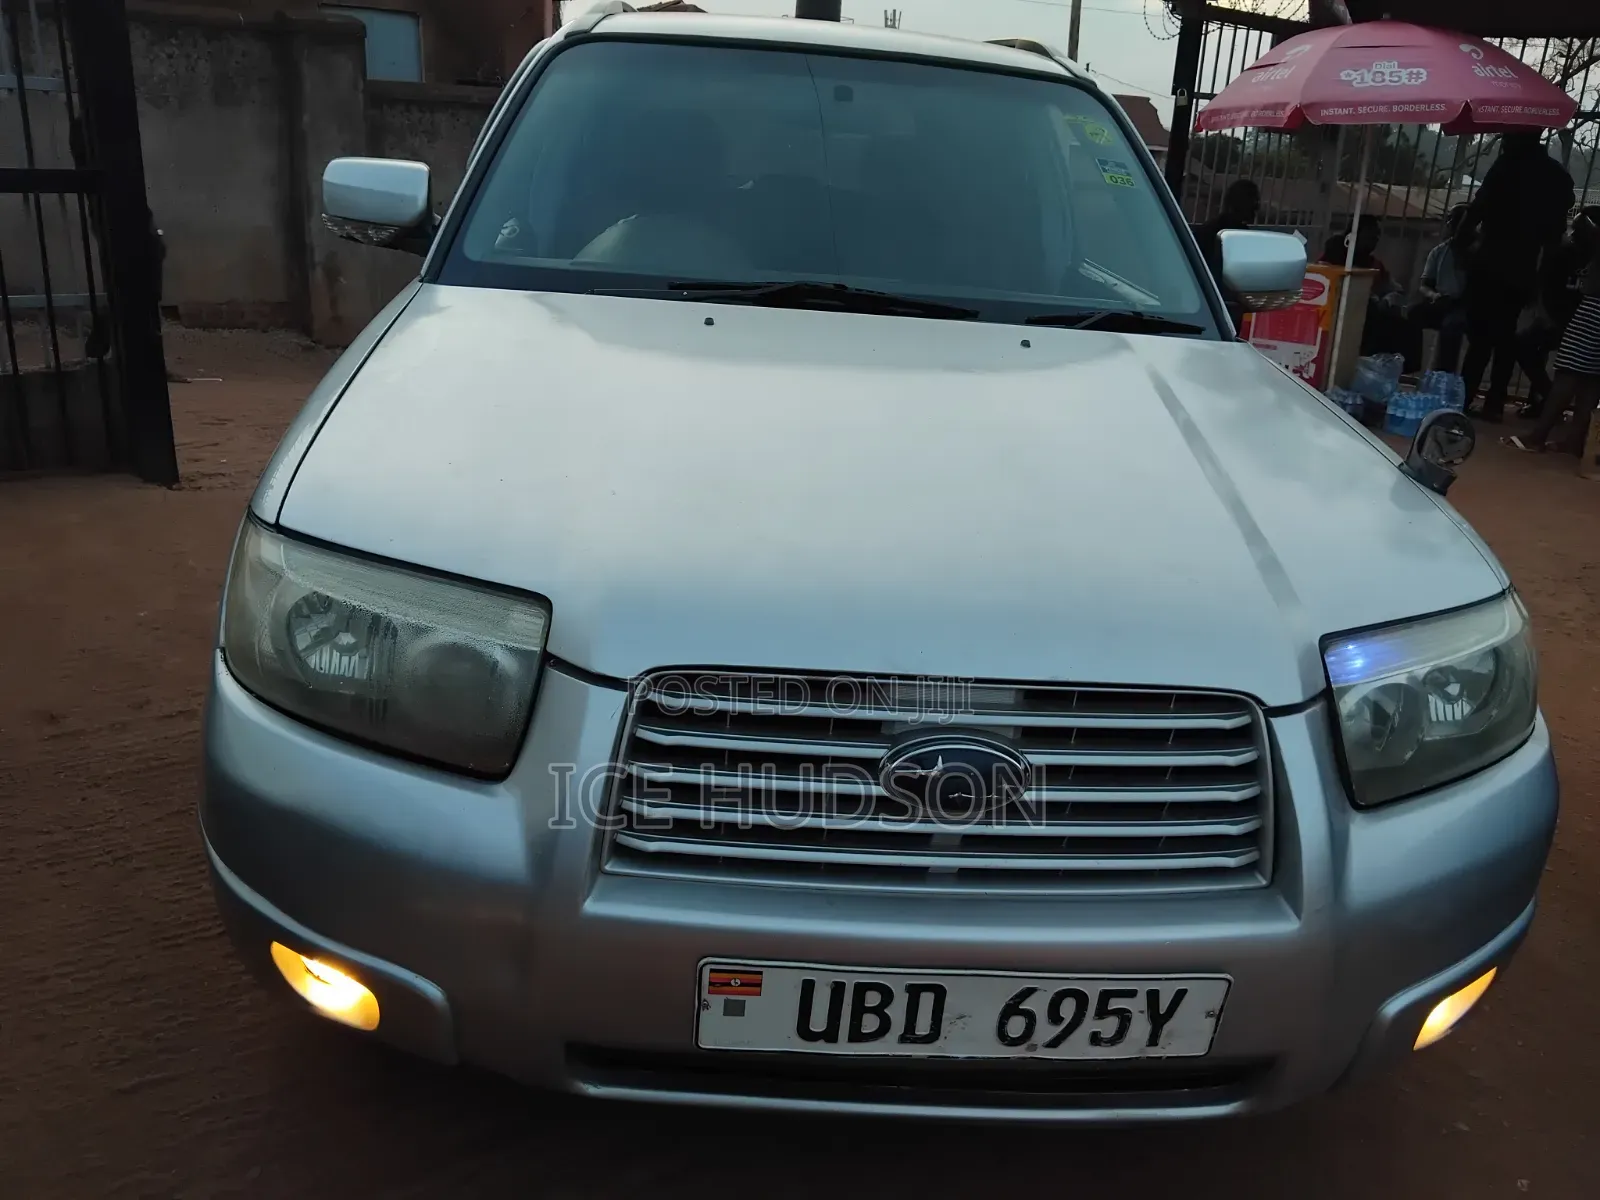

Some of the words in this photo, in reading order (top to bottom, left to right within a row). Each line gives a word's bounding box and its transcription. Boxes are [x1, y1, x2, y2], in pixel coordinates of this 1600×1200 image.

[1374, 61, 1396, 70] Dial
[1472, 62, 1518, 78] airtel
[1252, 65, 1296, 82] airtel
[1320, 107, 1355, 117] INSTANT.
[1357, 105, 1391, 114] SECURE.
[1392, 103, 1447, 113] BORDERLESS.
[1109, 175, 1135, 187] 036
[795, 977, 948, 1046] UBD
[995, 985, 1188, 1049] 695Y
